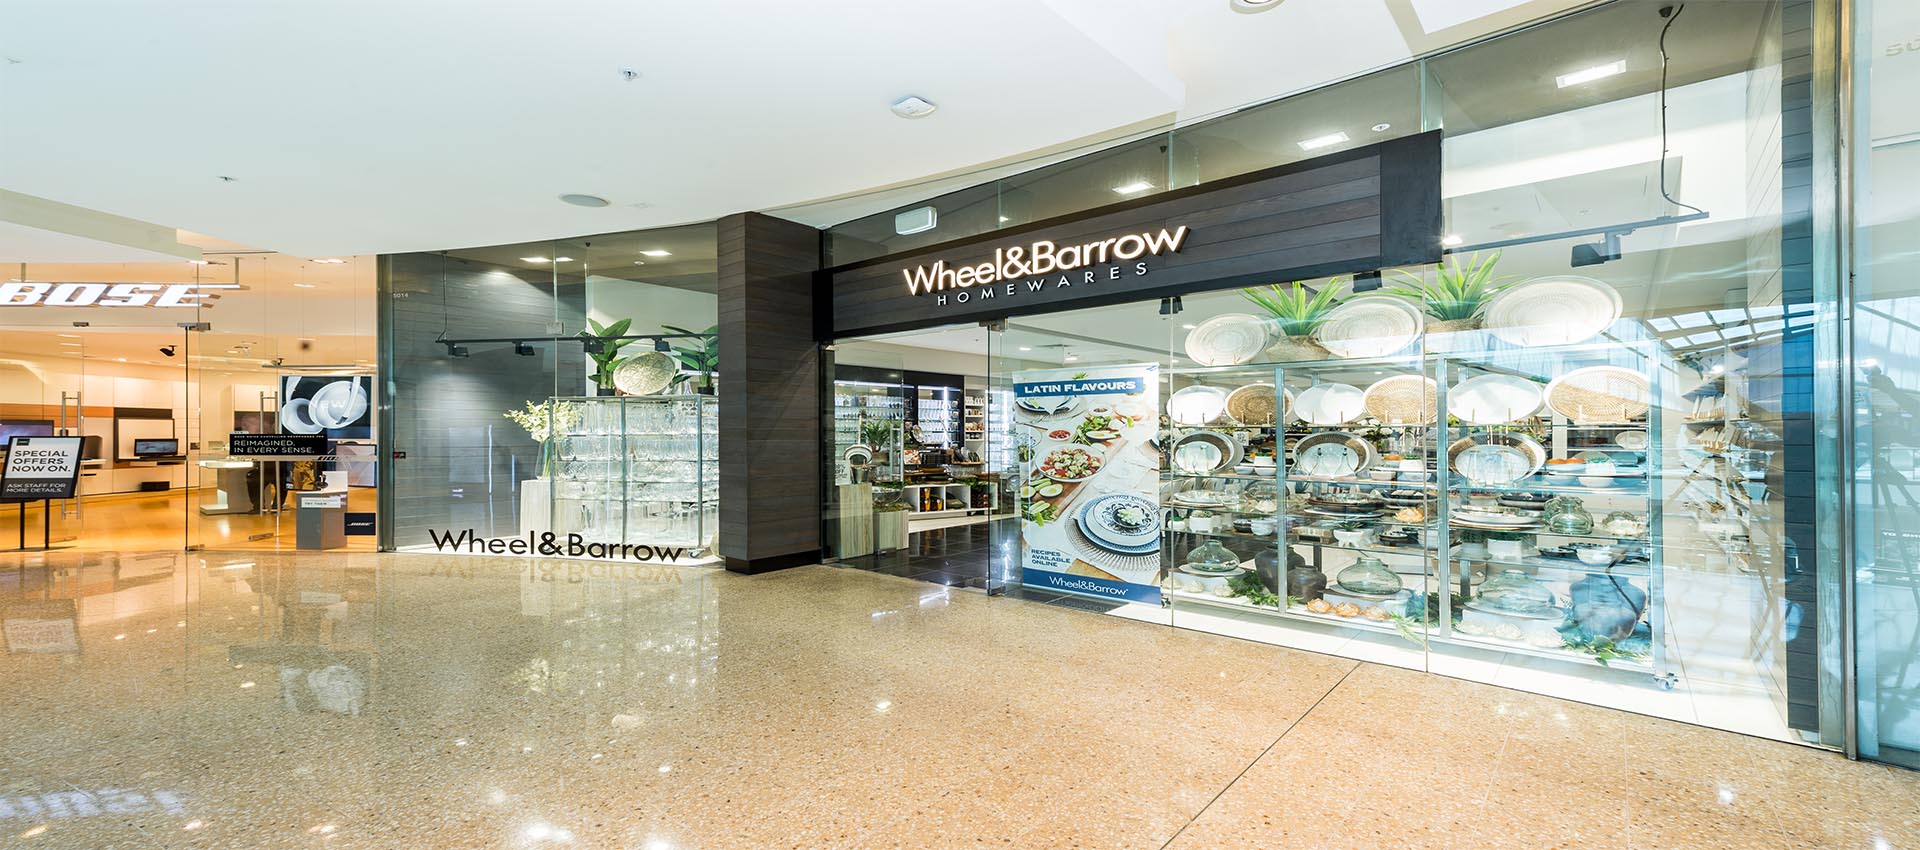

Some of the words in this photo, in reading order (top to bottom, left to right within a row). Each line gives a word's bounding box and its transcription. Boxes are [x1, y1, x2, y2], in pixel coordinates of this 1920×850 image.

[902, 225, 1188, 297] Wheel&Barrow
[936, 262, 1150, 306] HOMEWARES
[0, 282, 239, 307] BOSE
[1024, 384, 1061, 394] LATIN
[1064, 381, 1137, 393] FLAVOURS
[233, 439, 296, 447] REIMAGINED.
[13, 457, 65, 465] OFFERS
[428, 528, 684, 563] Wheel&Barrow
[1031, 548, 1061, 557] RECIPES
[1031, 554, 1071, 564] AVAILABLE
[1031, 559, 1058, 568] ONLINE
